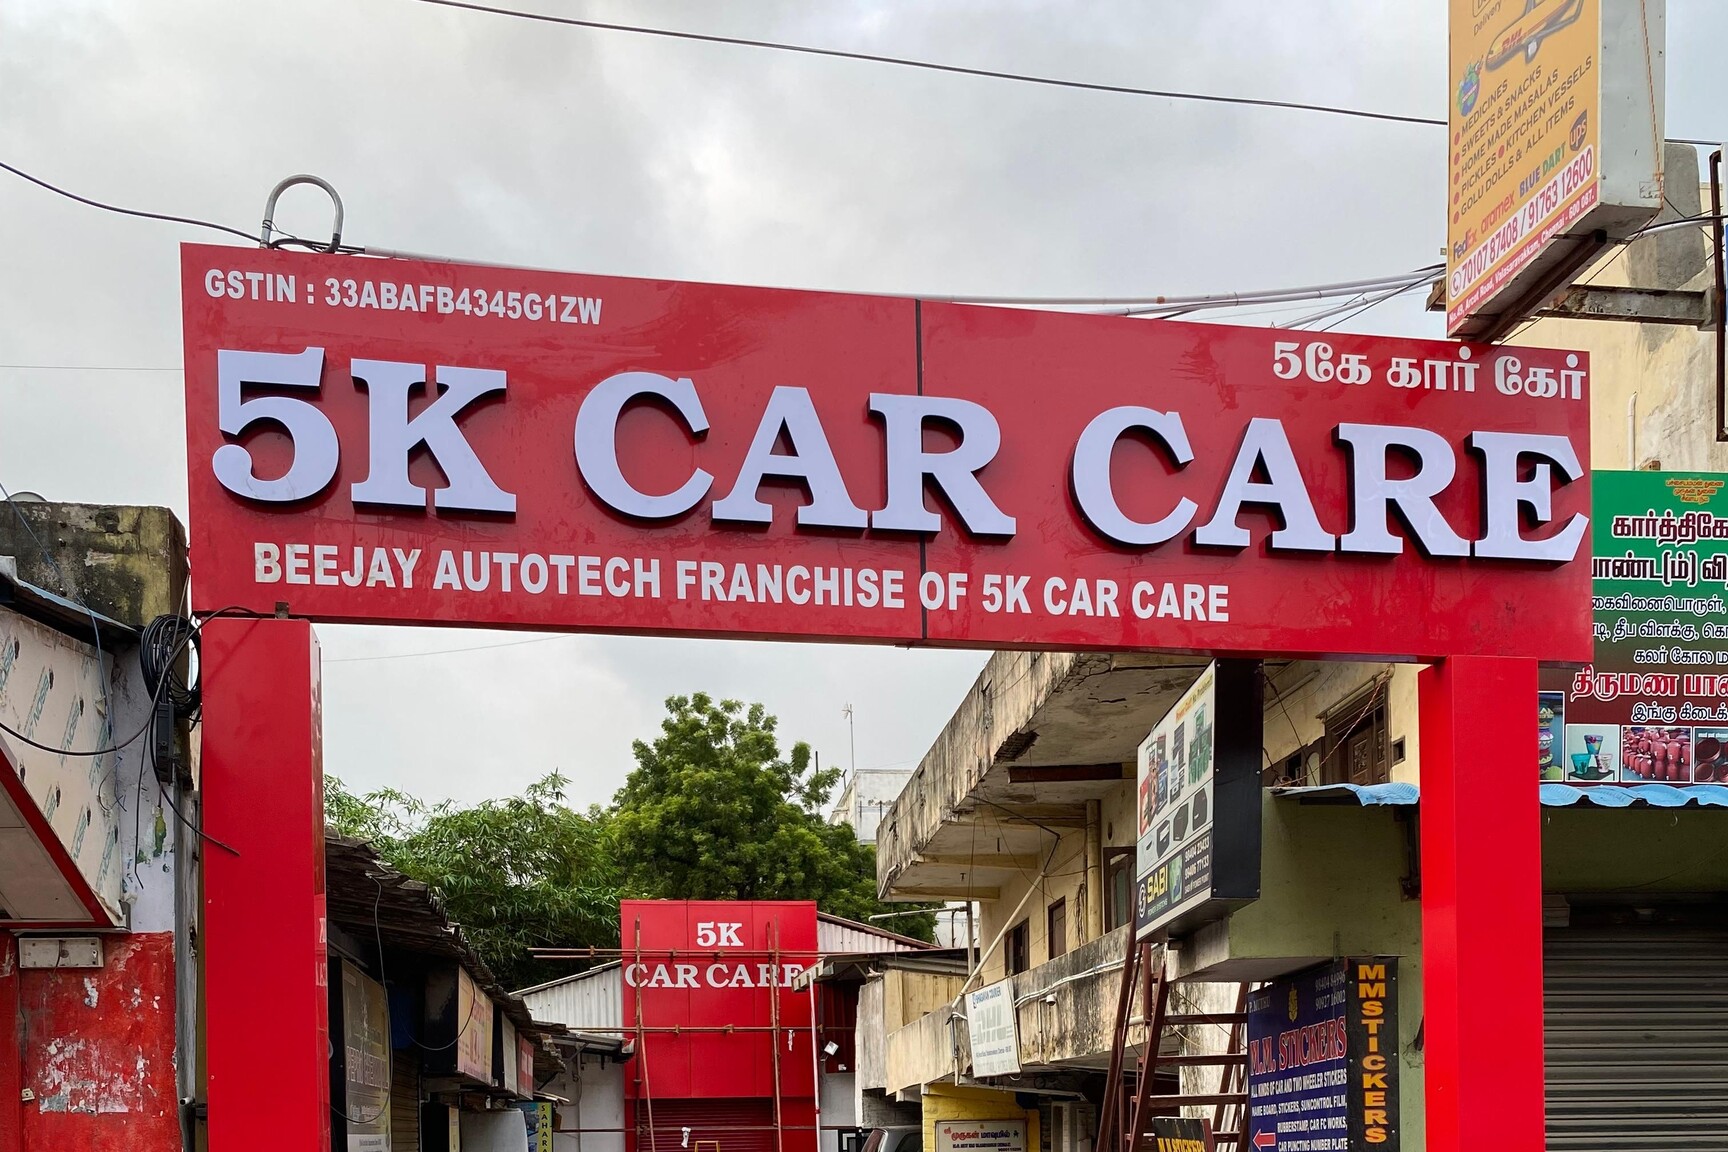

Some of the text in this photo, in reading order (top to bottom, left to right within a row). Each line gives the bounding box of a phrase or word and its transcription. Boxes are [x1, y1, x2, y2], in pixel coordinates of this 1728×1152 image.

[1461, 79, 1508, 137] MEDICINES
[1461, 113, 1496, 157] SWEETS
[1497, 106, 1504, 120] &
[1504, 65, 1542, 112] SNACKS
[1461, 68, 1559, 178] HOME MADE MASALAS
[1461, 56, 1592, 196] PICKLES KITCHEN VESSELS
[1461, 95, 1575, 216] GOLU DOLLS & ALL ITEMS
[1519, 141, 1566, 198] BLUE DART
[1462, 244, 1488, 290] 70107
[1489, 216, 1518, 264] 87408
[1528, 179, 1559, 229] 91763
[1561, 147, 1593, 199] 12600
[1480, 190, 1515, 234] aramex
[1453, 227, 1477, 263] FedEx
[204, 268, 296, 303] GSTIN
[325, 278, 603, 325] 33ABAFB4345G1ZW
[1272, 341, 1587, 400] 5கே கார் கேர்
[212, 346, 1590, 563] 5K CAR CARE
[254, 542, 1229, 622] BEEJAY AUTOTECH FRANCHISE OF 5K CAR CARE
[1613, 617, 1636, 642] தீப
[1639, 619, 1699, 641] விளக்கு,
[1634, 645, 1668, 664] கலர்
[1671, 646, 1713, 665] கோல
[1571, 664, 1679, 702] திருமண
[1631, 701, 1677, 723] இங்கு
[1147, 864, 1168, 904] SABI
[696, 921, 744, 947] 5K
[625, 963, 700, 988] CAR
[1279, 1015, 1347, 1071] STICKERS
[1275, 1080, 1283, 1094] CAR
[1284, 1078, 1292, 1093] AND
[1293, 1076, 1302, 1092] TWO
[1303, 1073, 1323, 1090] WHEELER
[1324, 1068, 1347, 1087] STICKERS
[1278, 1101, 1300, 1114] STICKERS,
[1301, 1096, 1332, 1112] SUNCONTROL
[1333, 1095, 1347, 1109] FILM,
[1310, 1118, 1319, 1130] CAR
[1320, 1118, 1327, 1130] FC
[1327, 1116, 1347, 1130] WORKS,
[951, 1131, 979, 1141] முருகன்
[1278, 1141, 1287, 1152] CAR
[1310, 1139, 1331, 1151] NUMBER
[1331, 1138, 1348, 1150] PLATE
